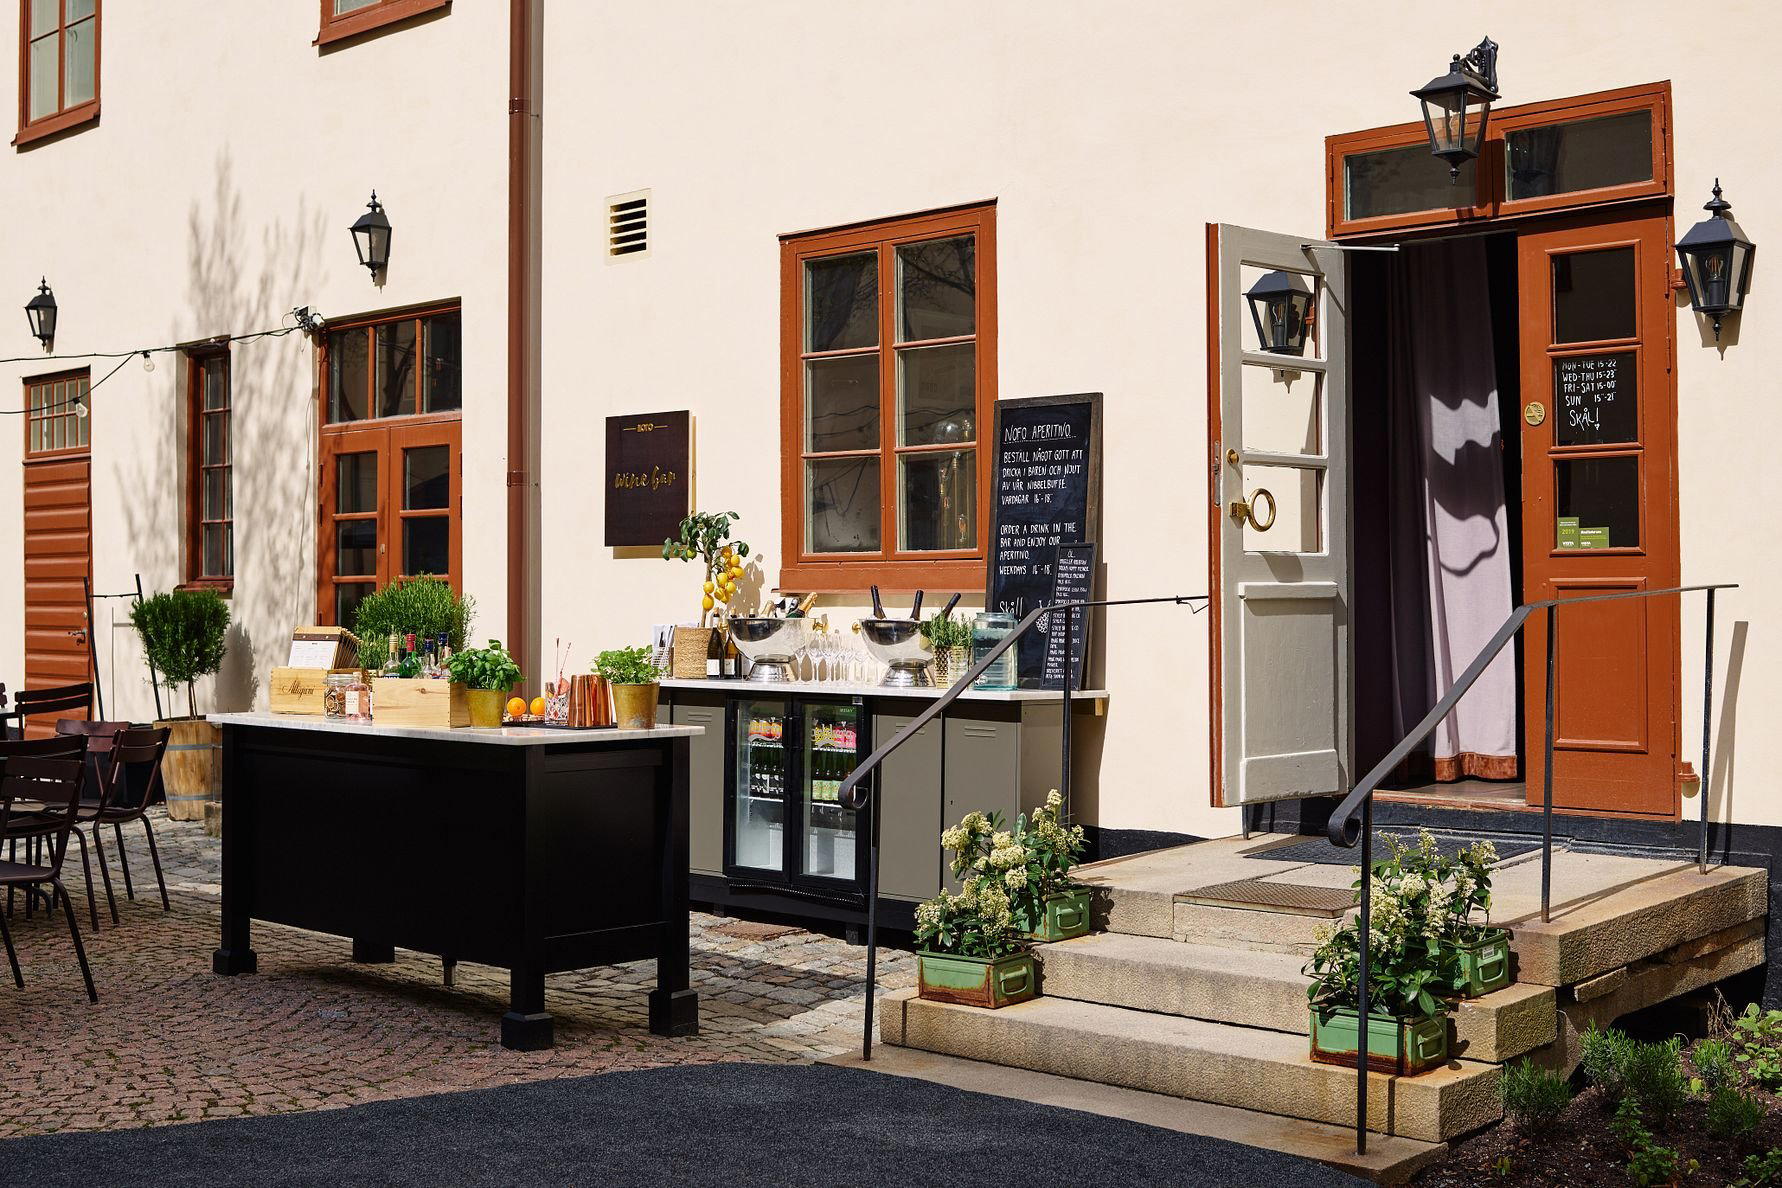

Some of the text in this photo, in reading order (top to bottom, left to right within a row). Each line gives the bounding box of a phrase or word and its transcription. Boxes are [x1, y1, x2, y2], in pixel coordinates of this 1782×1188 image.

[1565, 395, 1582, 407] SUN
[1005, 424, 1027, 441] NOFO
[1054, 449, 1070, 461] GOTT
[1071, 449, 1083, 460] ATT
[1048, 465, 1062, 476] OCH
[1001, 481, 1012, 491] AV
[1000, 522, 1077, 536] ORDER A DRINK IN THE
[1000, 535, 1060, 548] BAR AND ENJOY OUR
[999, 565, 1027, 575] WEEKDAYS
